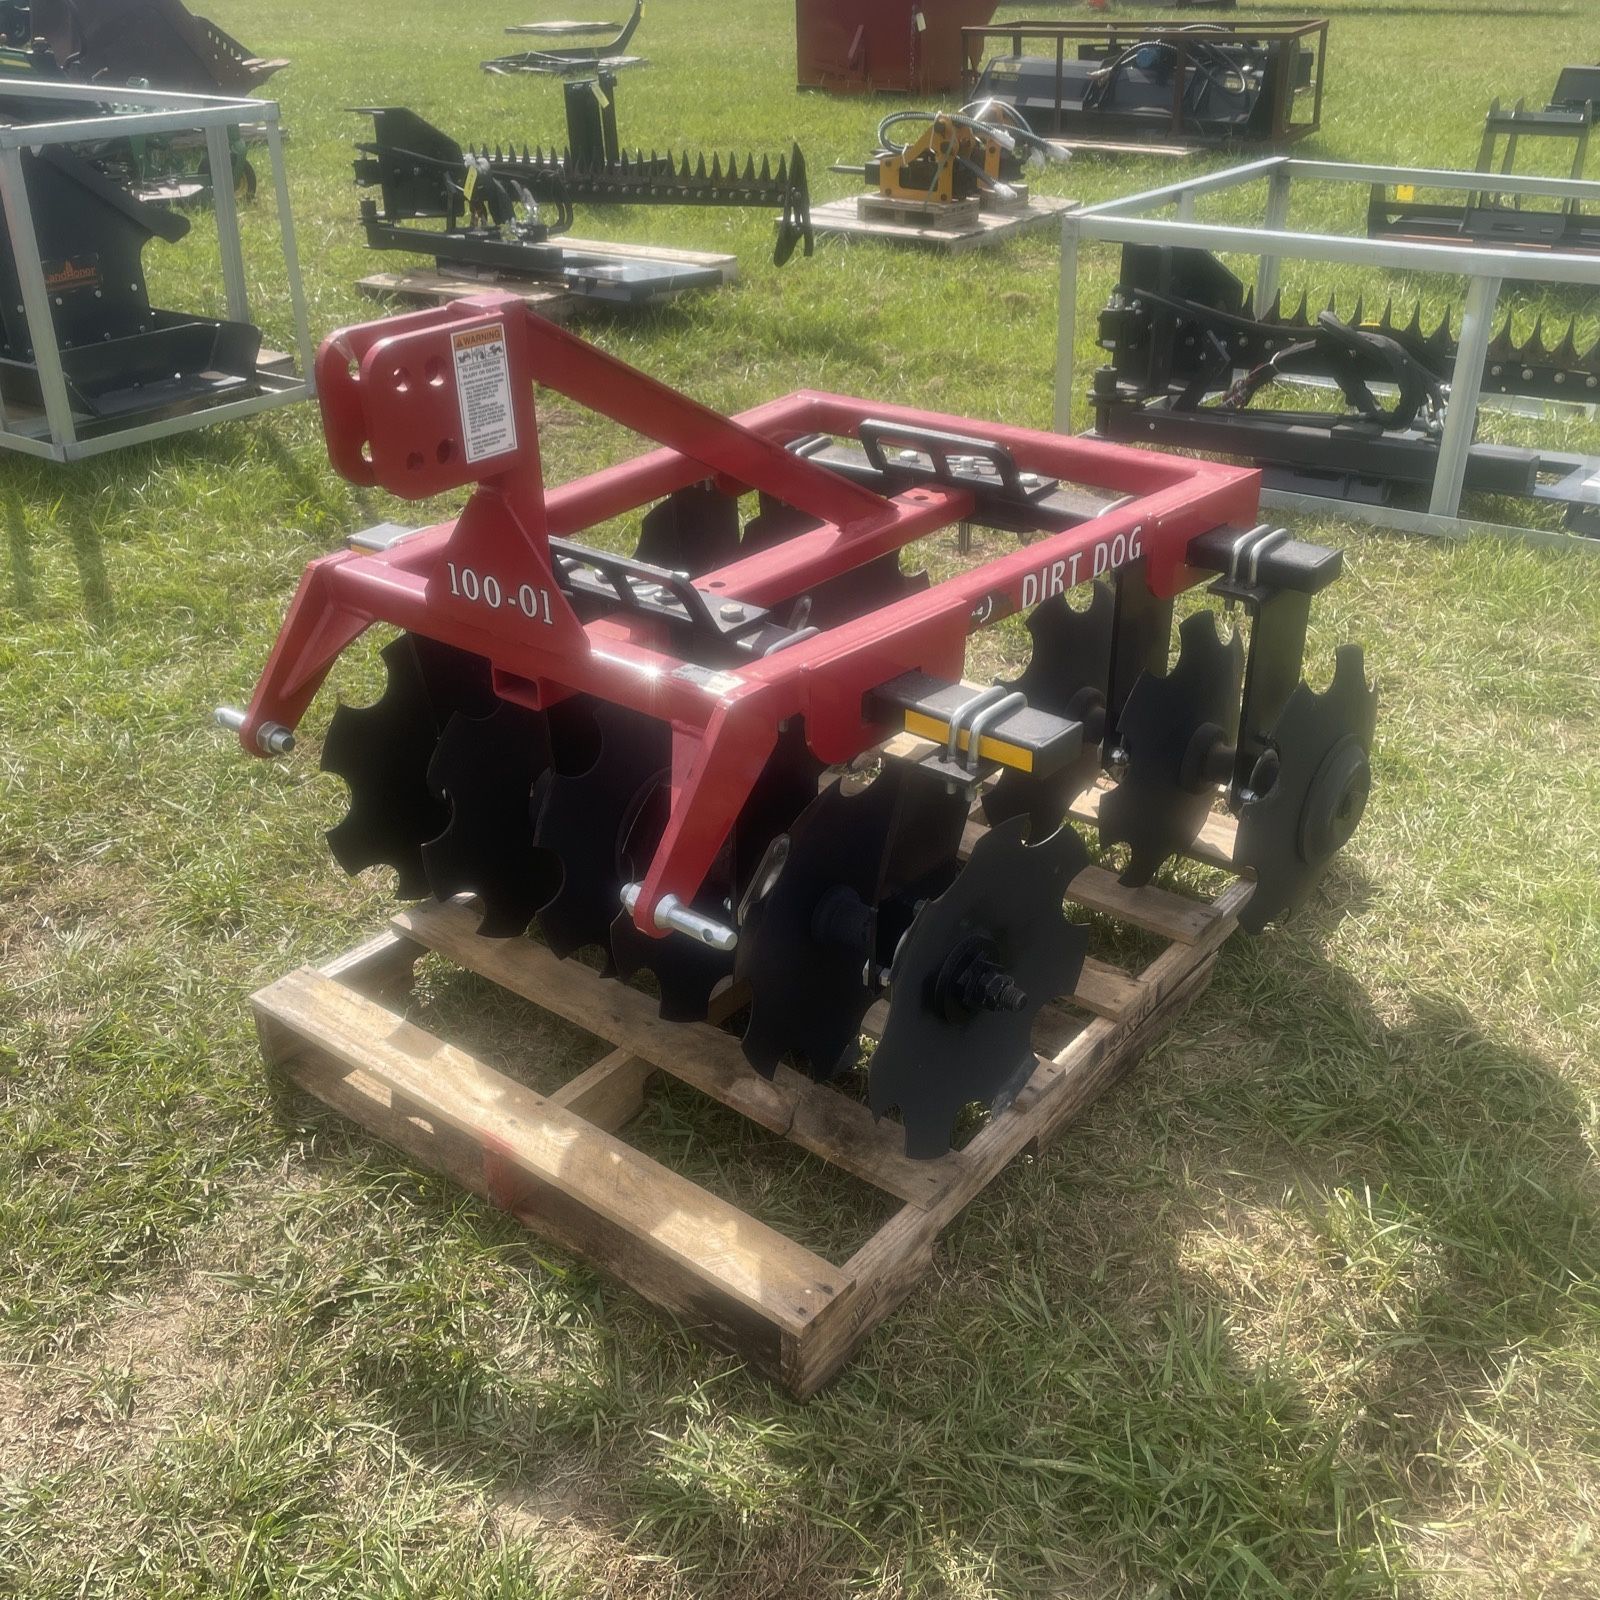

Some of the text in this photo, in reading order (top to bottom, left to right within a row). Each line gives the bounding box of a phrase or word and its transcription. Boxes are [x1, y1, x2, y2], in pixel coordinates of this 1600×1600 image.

[46, 265, 97, 282] andHonor
[463, 329, 501, 346] WARNING
[1022, 525, 1142, 609] DIRT DOG
[447, 562, 553, 625] 100-01
